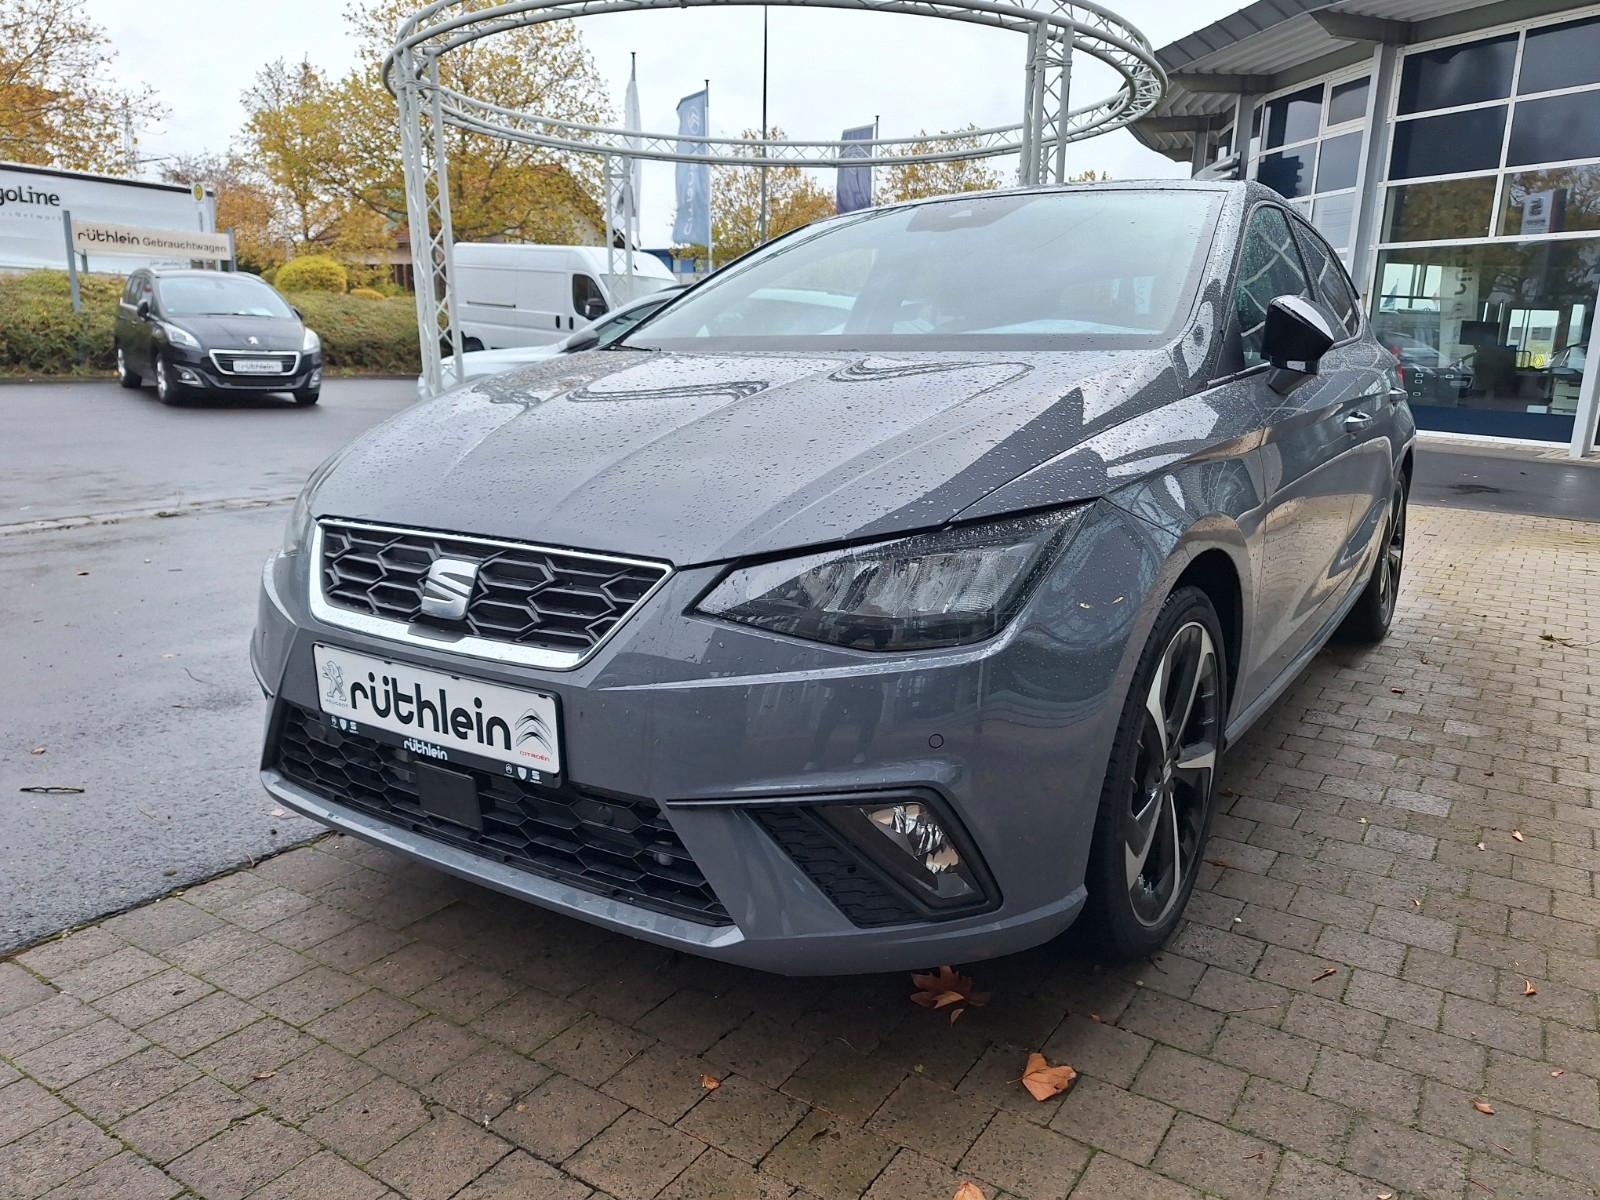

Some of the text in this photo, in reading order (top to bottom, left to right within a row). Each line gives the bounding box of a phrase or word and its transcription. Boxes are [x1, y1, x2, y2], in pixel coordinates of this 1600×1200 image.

[77, 228, 227, 254] rüthlein Gebrauchtwagen
[350, 671, 512, 751] rüthlein
[403, 737, 448, 761] rüthlein
